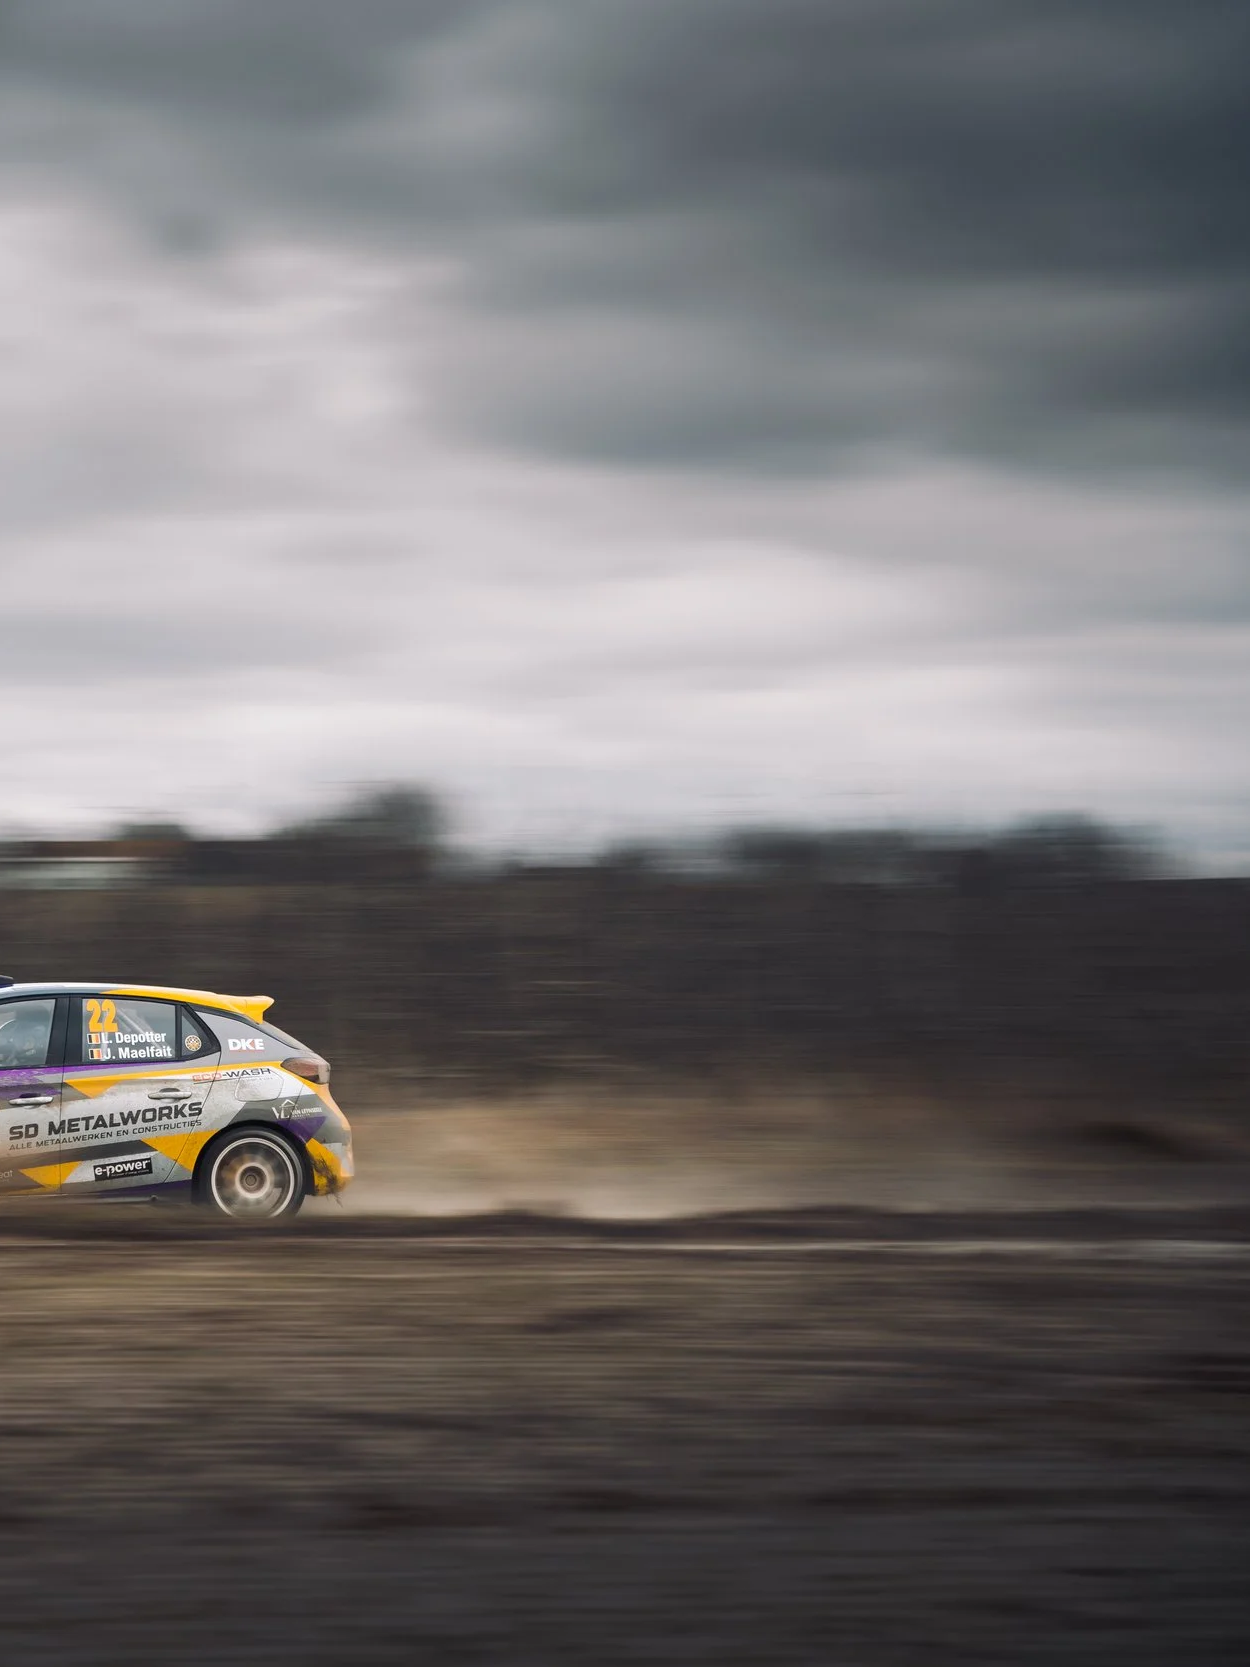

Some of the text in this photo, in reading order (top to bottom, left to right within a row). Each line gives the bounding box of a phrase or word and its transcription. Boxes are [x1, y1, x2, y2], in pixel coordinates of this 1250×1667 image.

[86, 999, 118, 1033] 22
[101, 1031, 166, 1045] L. Depotter
[228, 1038, 265, 1051] DKE
[103, 1045, 172, 1060] J. Maelfait
[192, 1067, 271, 1082] ECO-WASH
[9, 1101, 202, 1140] SD METALWORKS
[9, 1119, 202, 1150] ALLE METAALWERKEN EN CONSTRUCTIES
[95, 1160, 149, 1178] e-power
